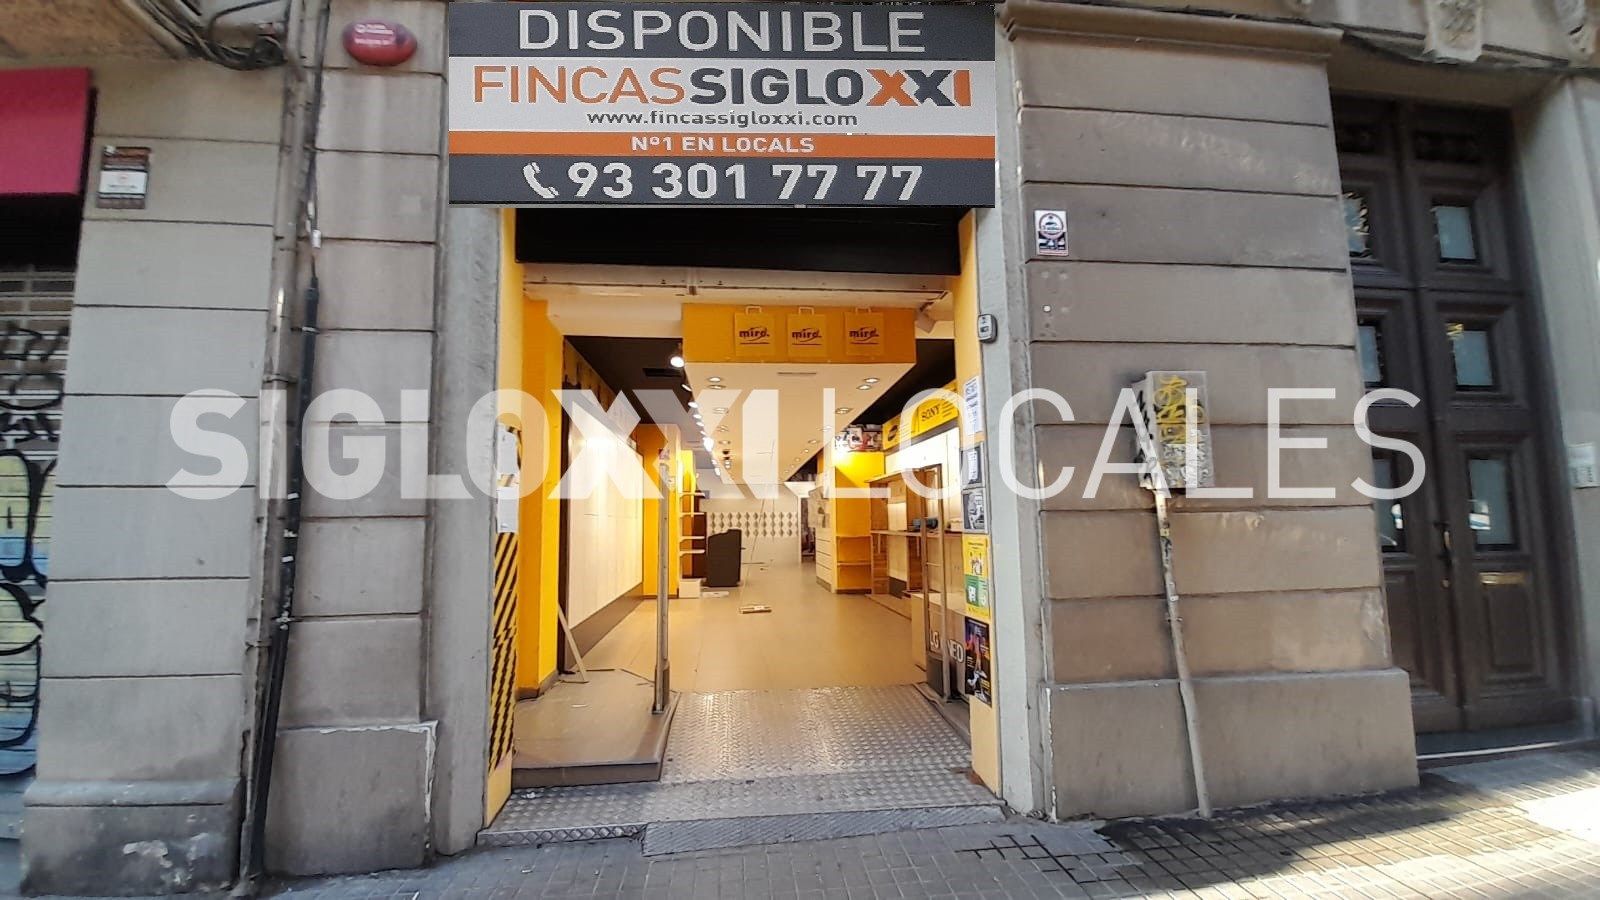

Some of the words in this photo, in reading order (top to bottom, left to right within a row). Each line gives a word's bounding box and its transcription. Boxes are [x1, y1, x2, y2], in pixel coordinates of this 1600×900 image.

[518, 9, 926, 53] DISPONIBLE
[473, 65, 972, 108] FINCASSIGLOXXI
[586, 109, 858, 129] www.fincassigloxxi.com
[682, 136, 714, 153] EN
[722, 136, 815, 154] LOCALS
[567, 162, 633, 199] 93
[651, 163, 748, 200] 301
[772, 164, 838, 201] 77
[857, 165, 923, 202] 77
[921, 403, 941, 421] SONY
